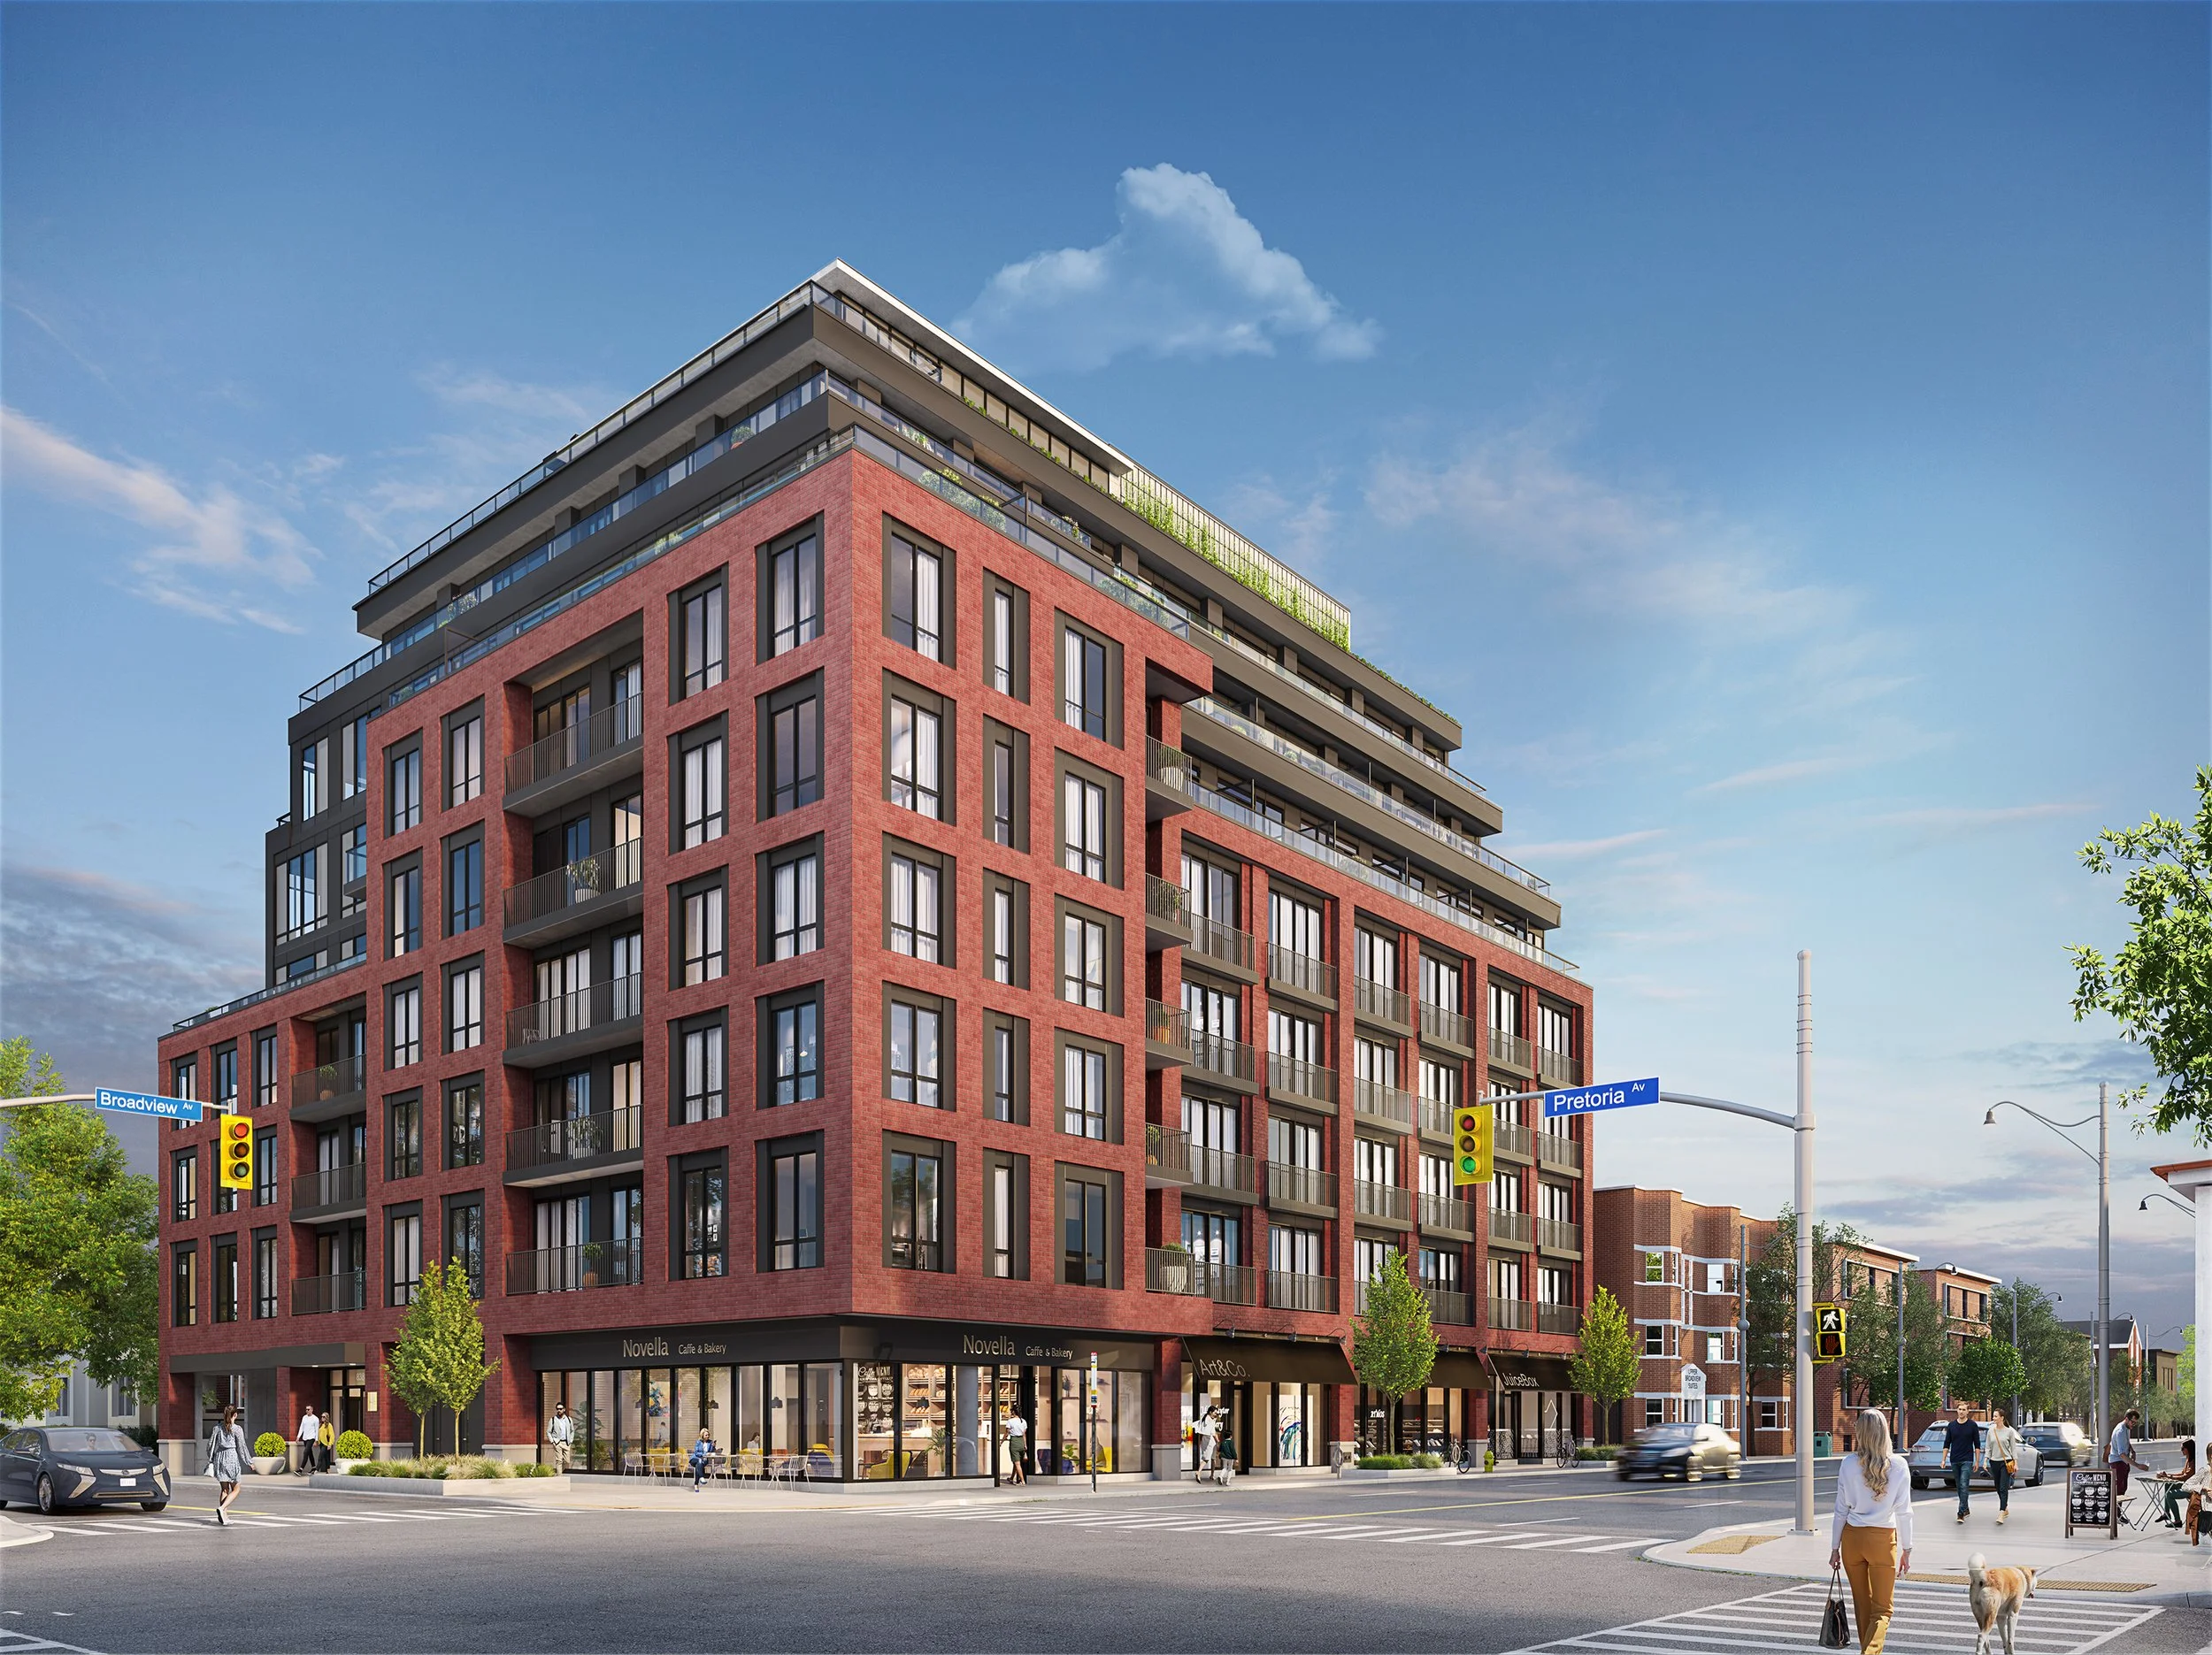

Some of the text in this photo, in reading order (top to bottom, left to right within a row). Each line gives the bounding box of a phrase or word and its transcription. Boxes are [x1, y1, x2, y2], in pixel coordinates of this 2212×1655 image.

[100, 1091, 194, 1115] Broadview Av
[1554, 1082, 1646, 1112] Pretoria Av
[623, 1337, 727, 1358] Novella Caffe & Bakery
[963, 1334, 1073, 1360] Novella Caffe & Bakery
[1199, 1358, 1251, 1378] Art&Co.
[1502, 1372, 1540, 1388] JuiceBox
